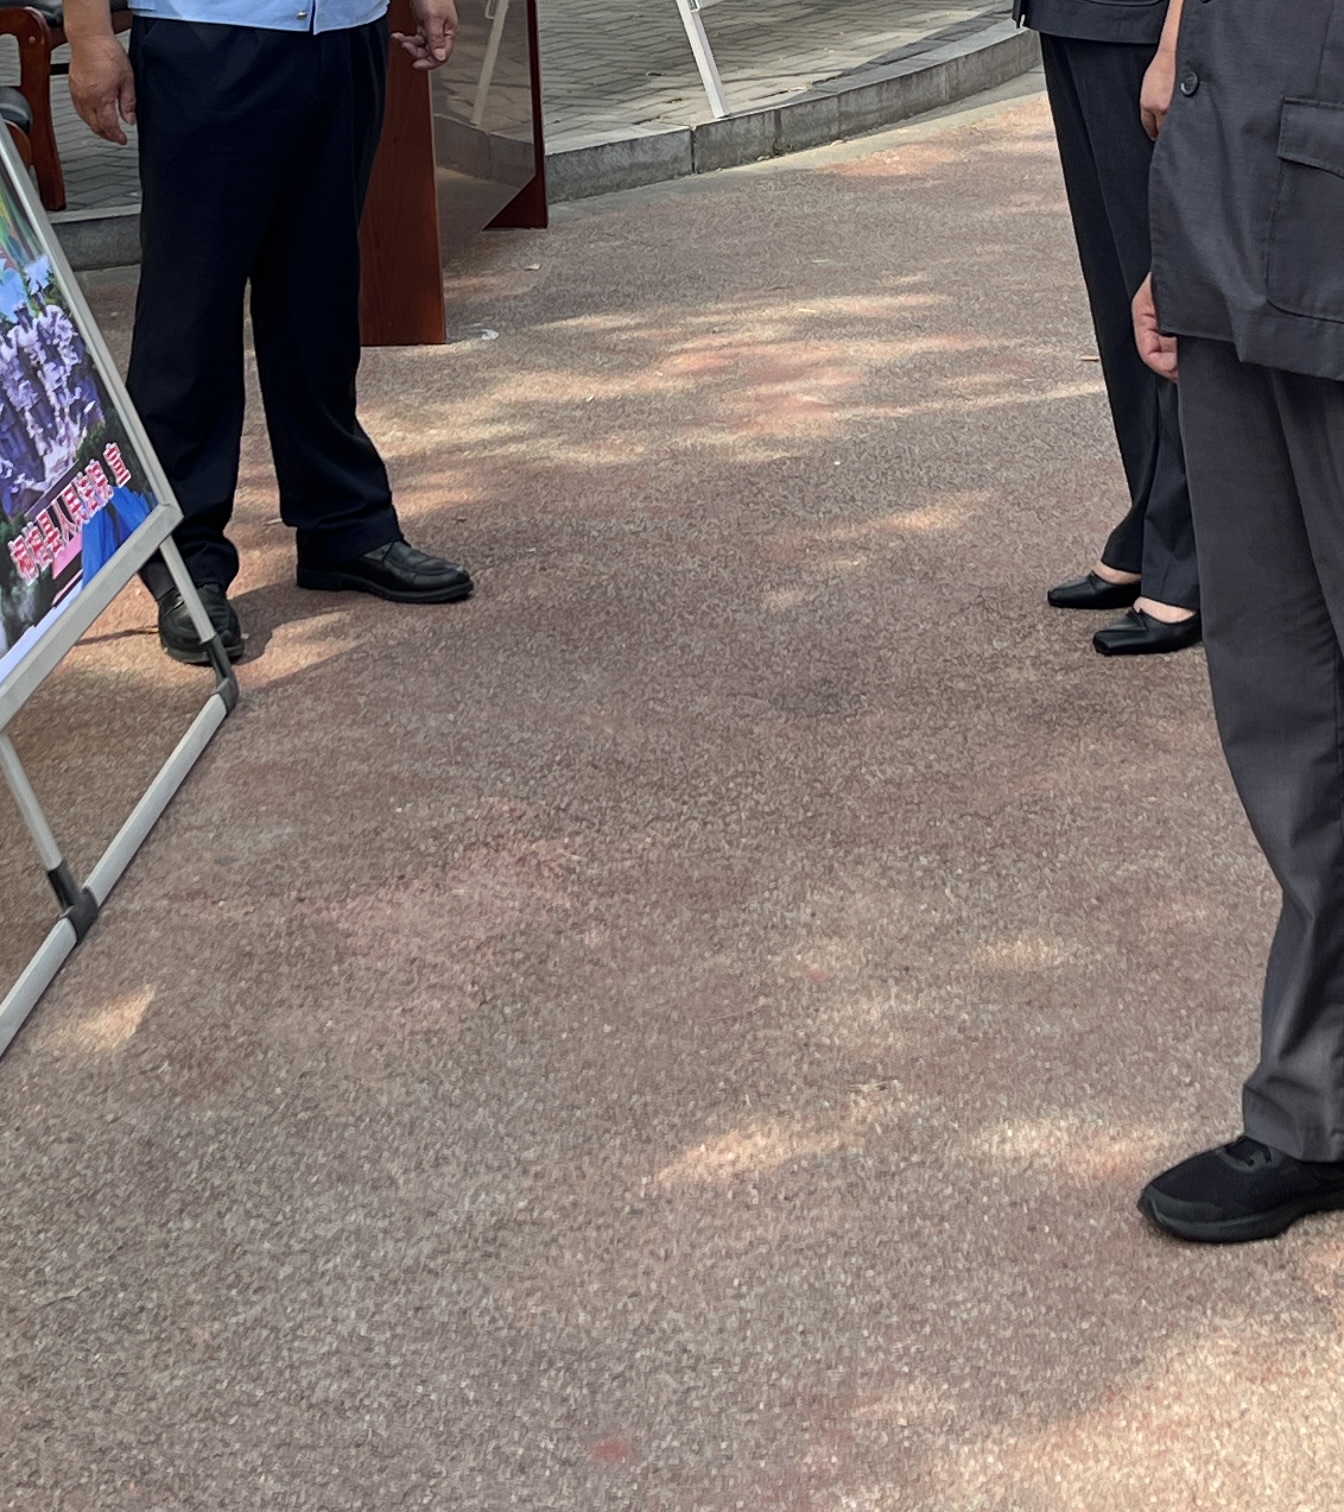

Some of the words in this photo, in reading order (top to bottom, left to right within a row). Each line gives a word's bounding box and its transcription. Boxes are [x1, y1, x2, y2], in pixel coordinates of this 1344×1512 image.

[8, 459, 113, 586] 桐柏县人民法院
[103, 442, 132, 488] 宣
